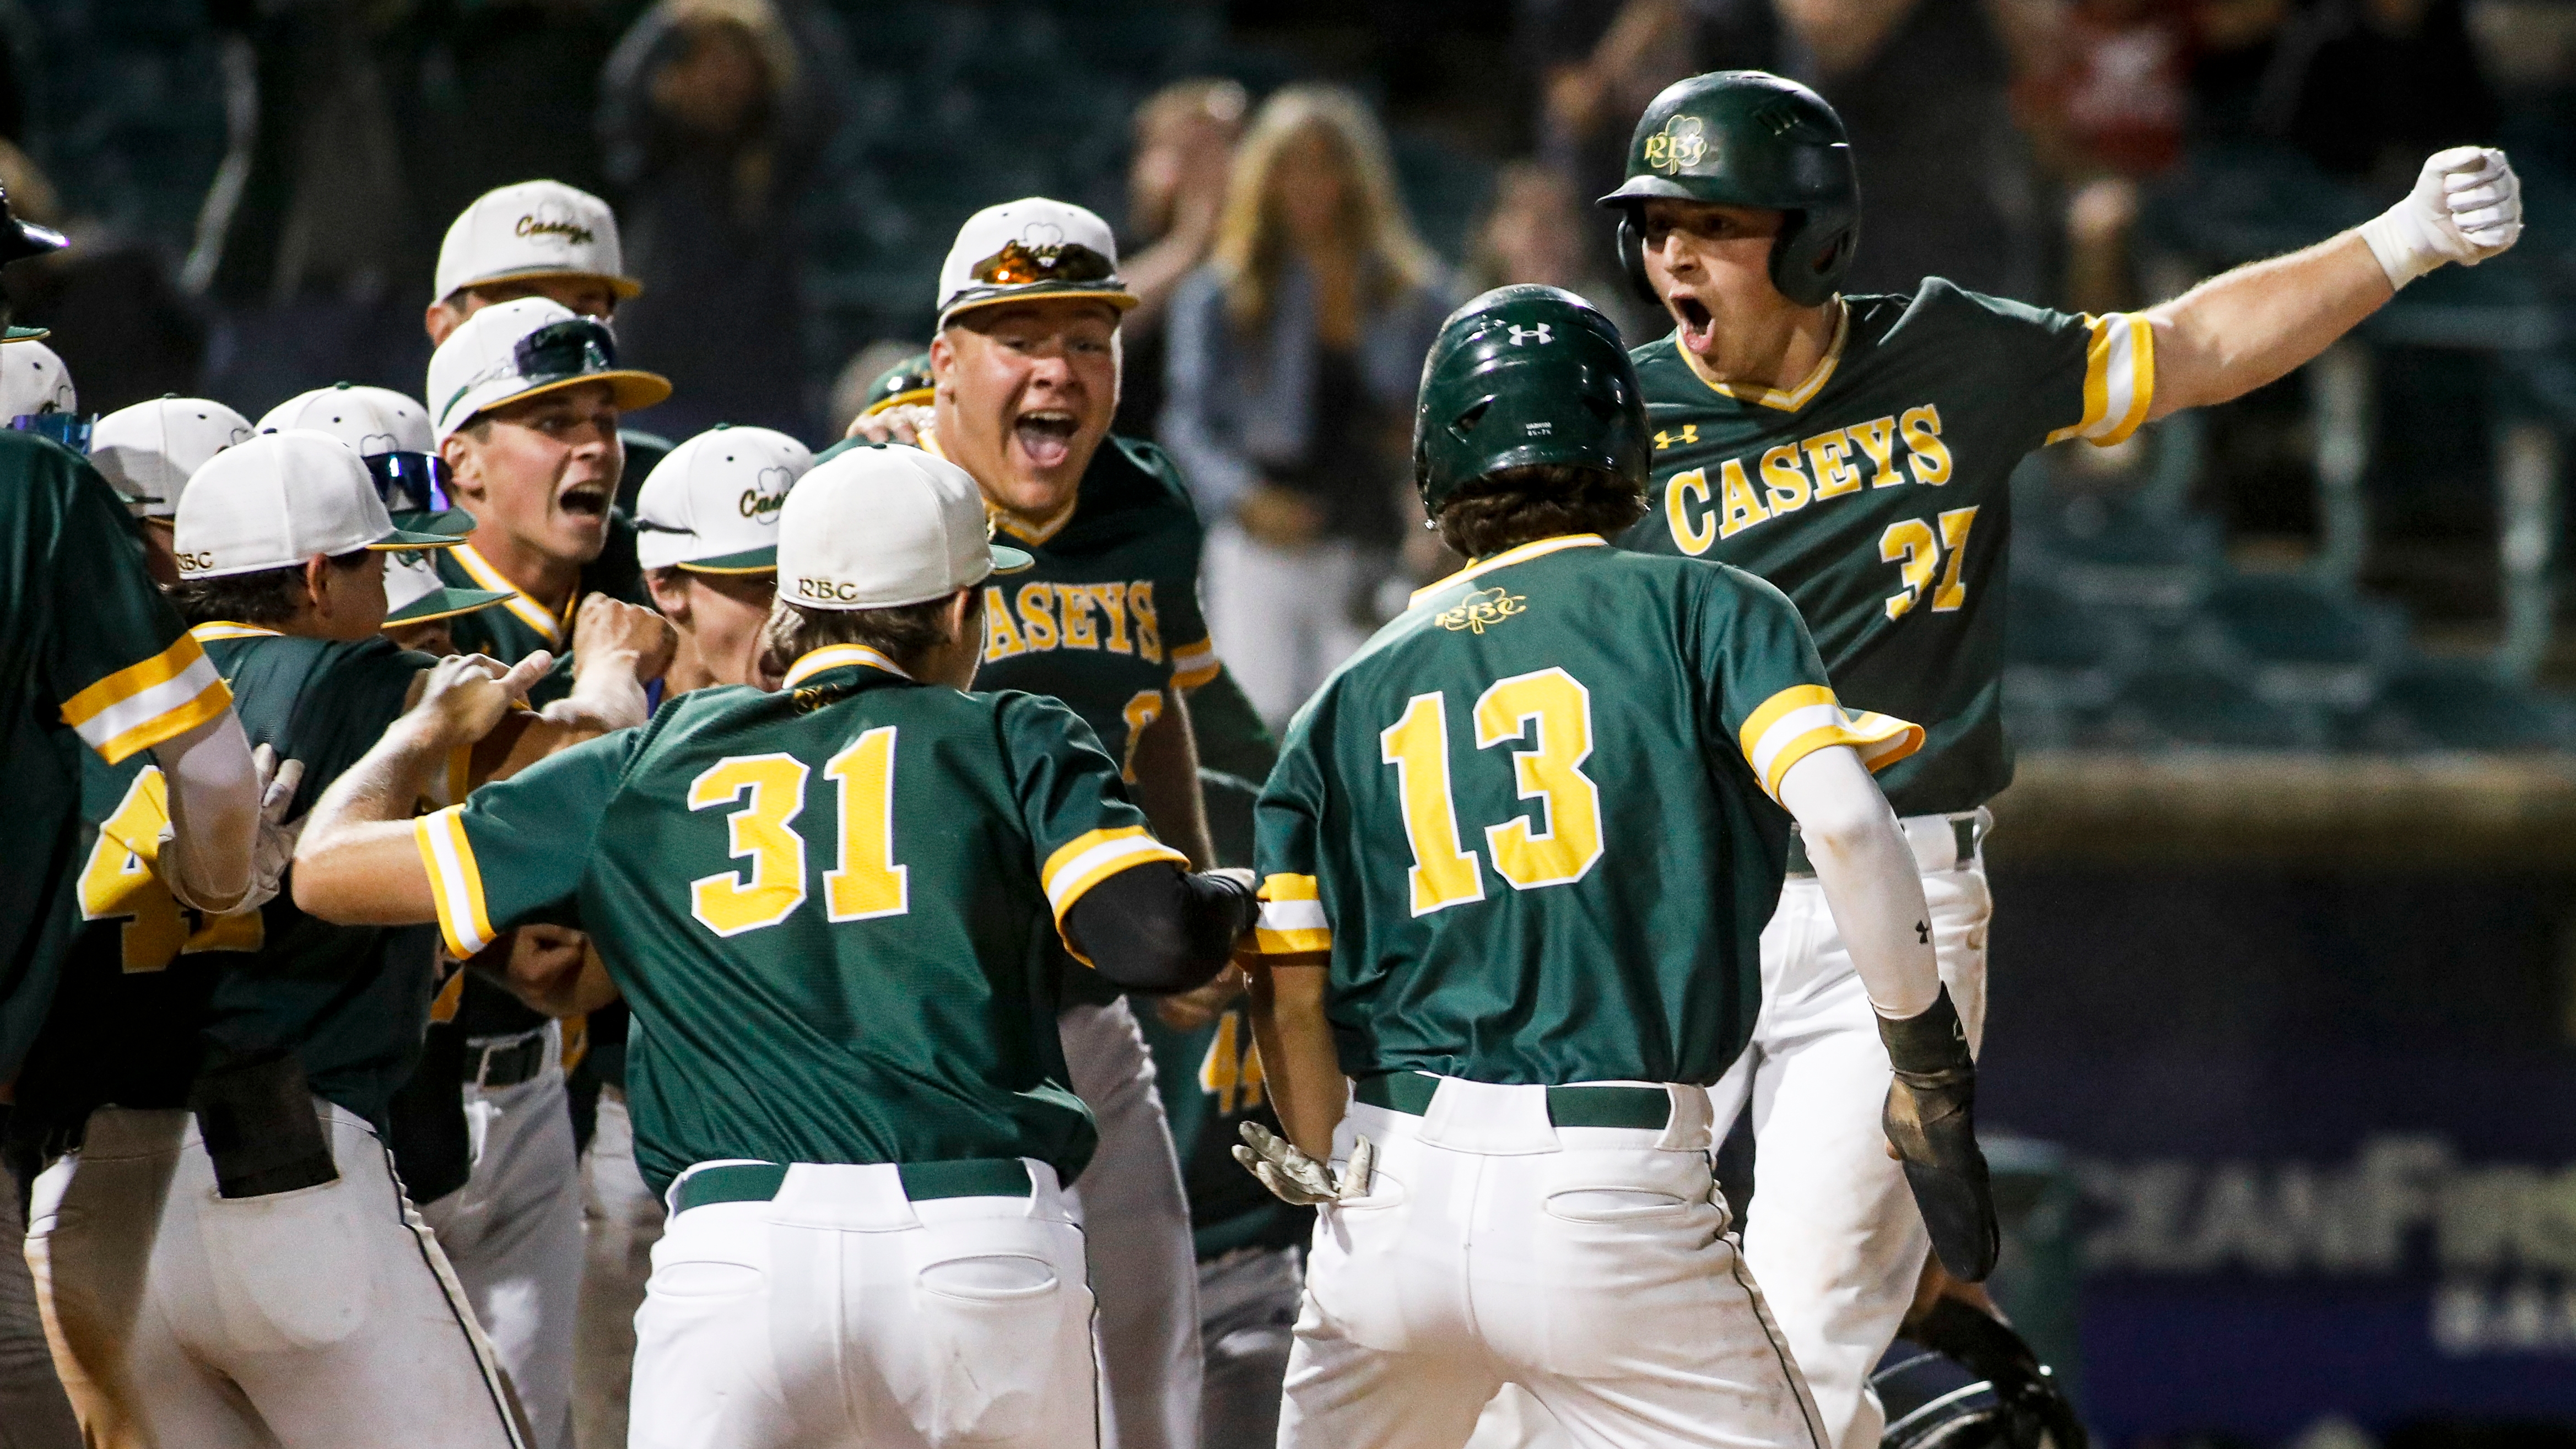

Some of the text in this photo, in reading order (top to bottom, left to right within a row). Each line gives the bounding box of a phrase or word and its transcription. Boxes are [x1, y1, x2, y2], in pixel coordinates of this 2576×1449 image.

[1664, 403, 1953, 556] CASEYS
[798, 578, 857, 600] RBC
[1434, 595, 1527, 627] RBC
[687, 725, 909, 938] 31
[1380, 666, 1605, 918] 13
